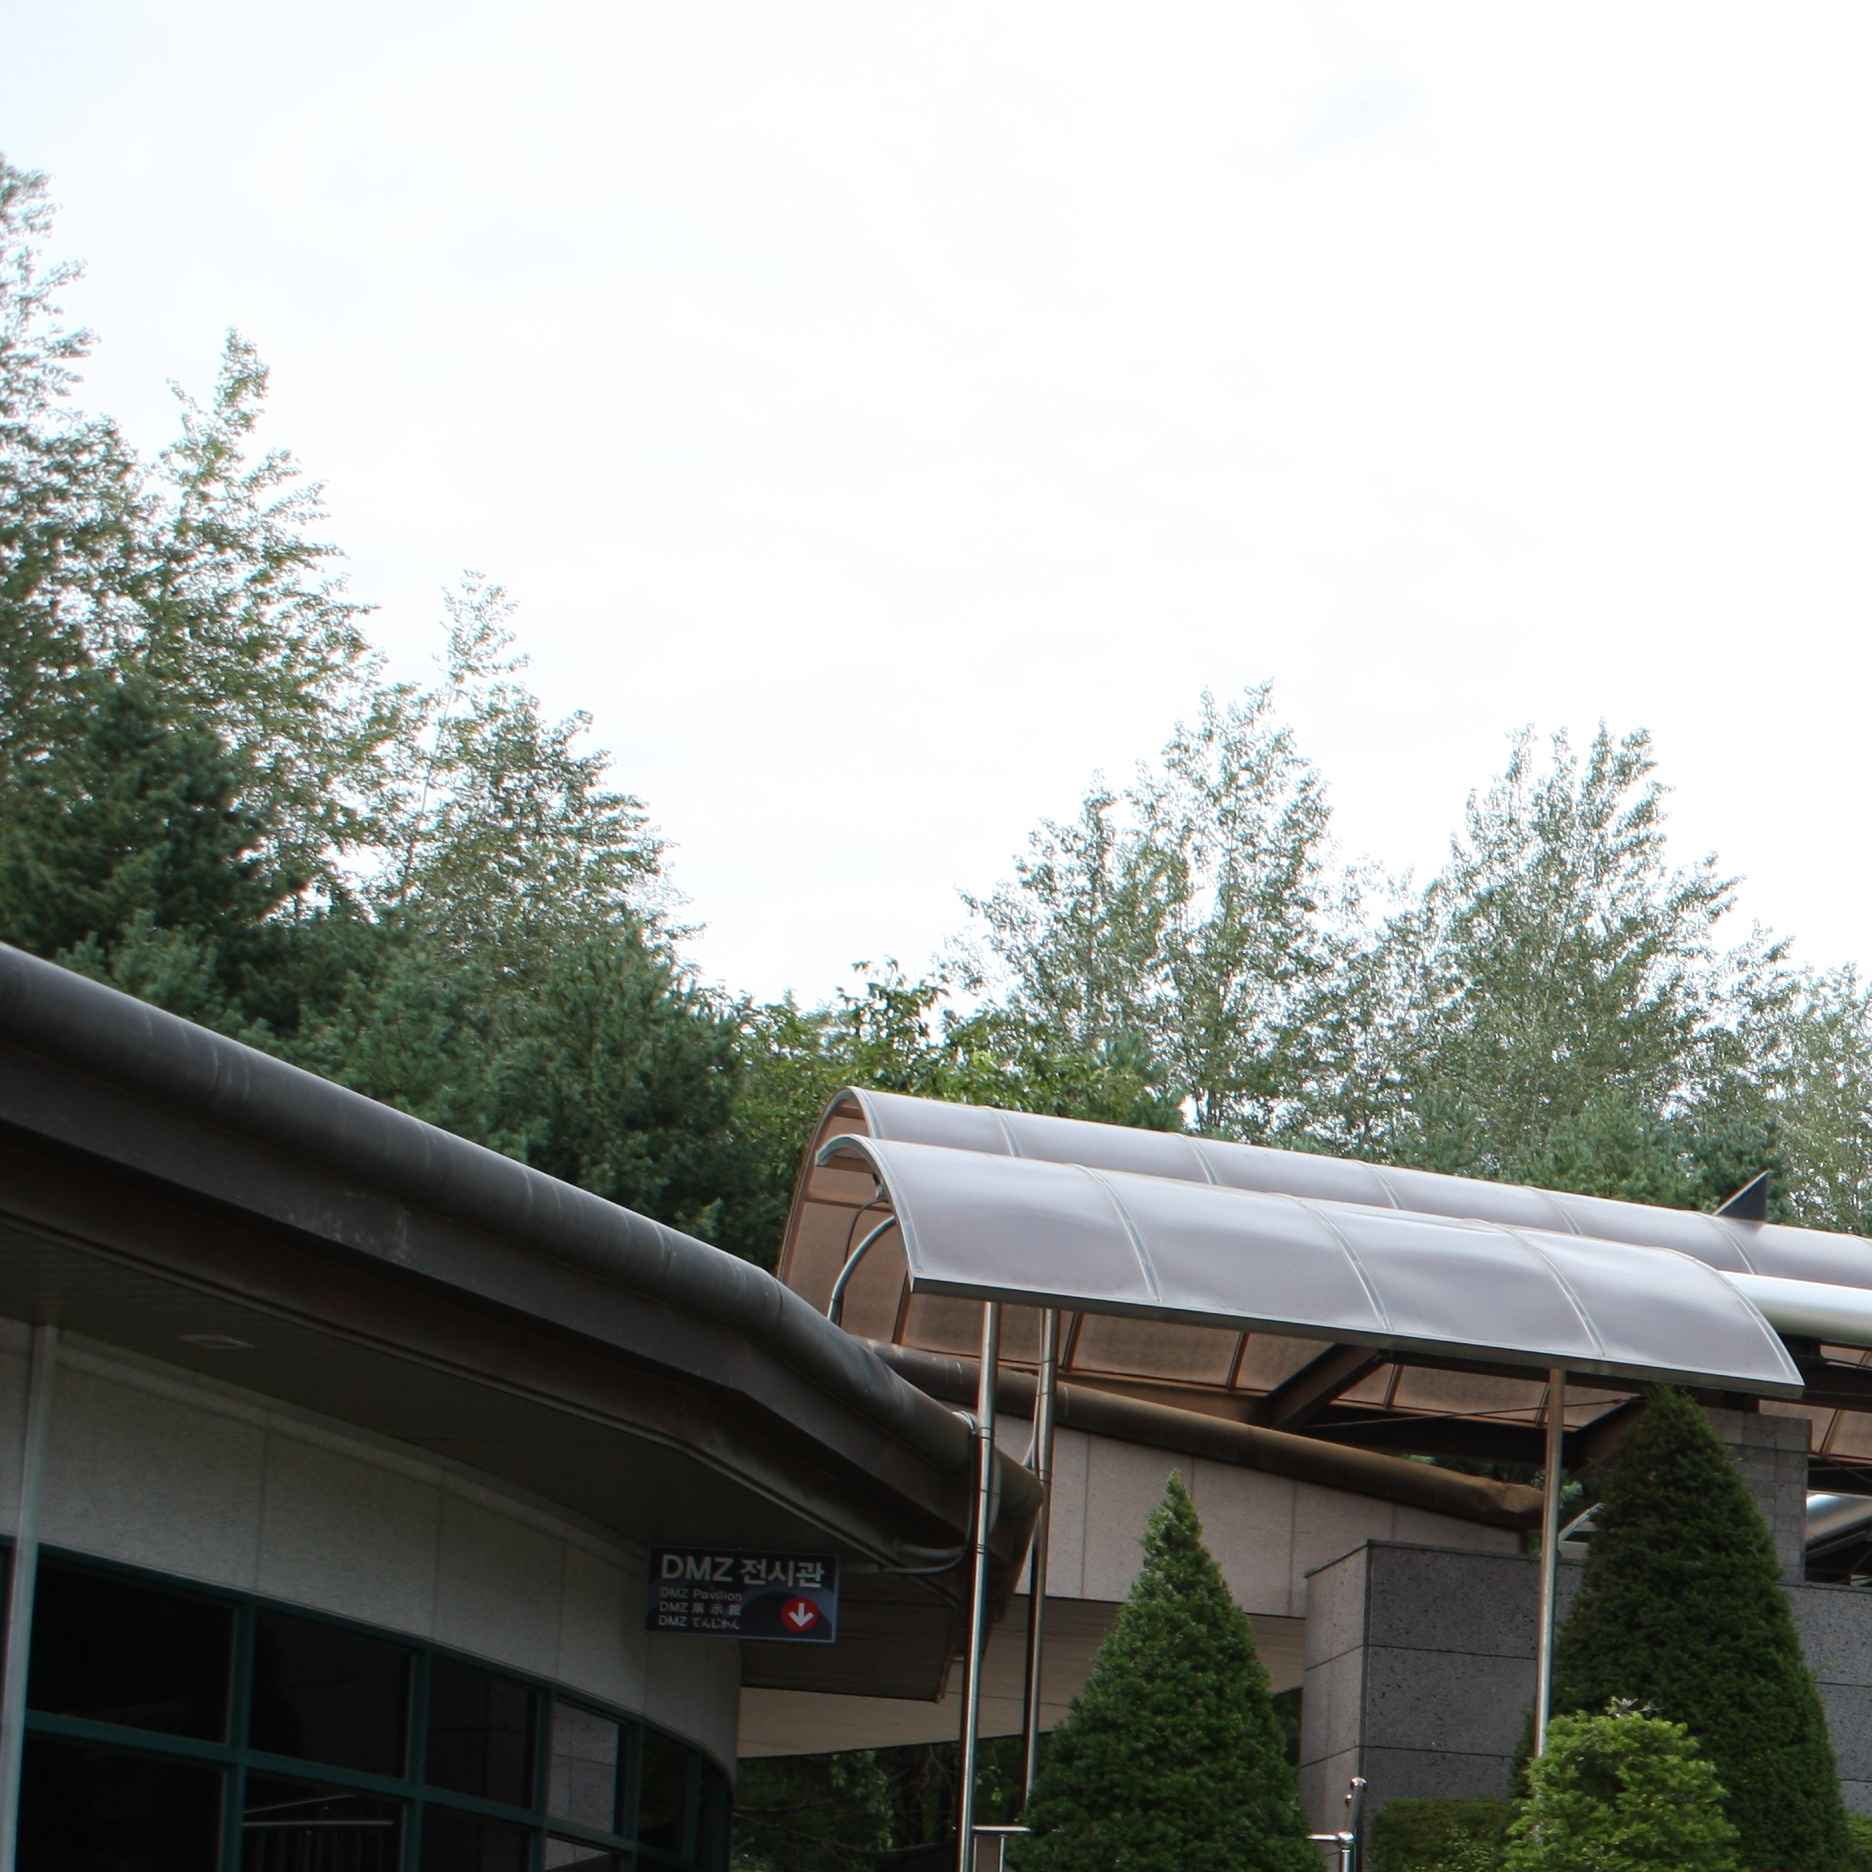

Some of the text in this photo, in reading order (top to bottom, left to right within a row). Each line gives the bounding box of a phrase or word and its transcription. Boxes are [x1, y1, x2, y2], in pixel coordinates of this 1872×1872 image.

[661, 1554, 825, 1588] DMZ 전시관
[660, 1587, 743, 1602] DMZ Pavilion
[659, 1602, 688, 1613] DMZ
[658, 1615, 688, 1627] DMZ
